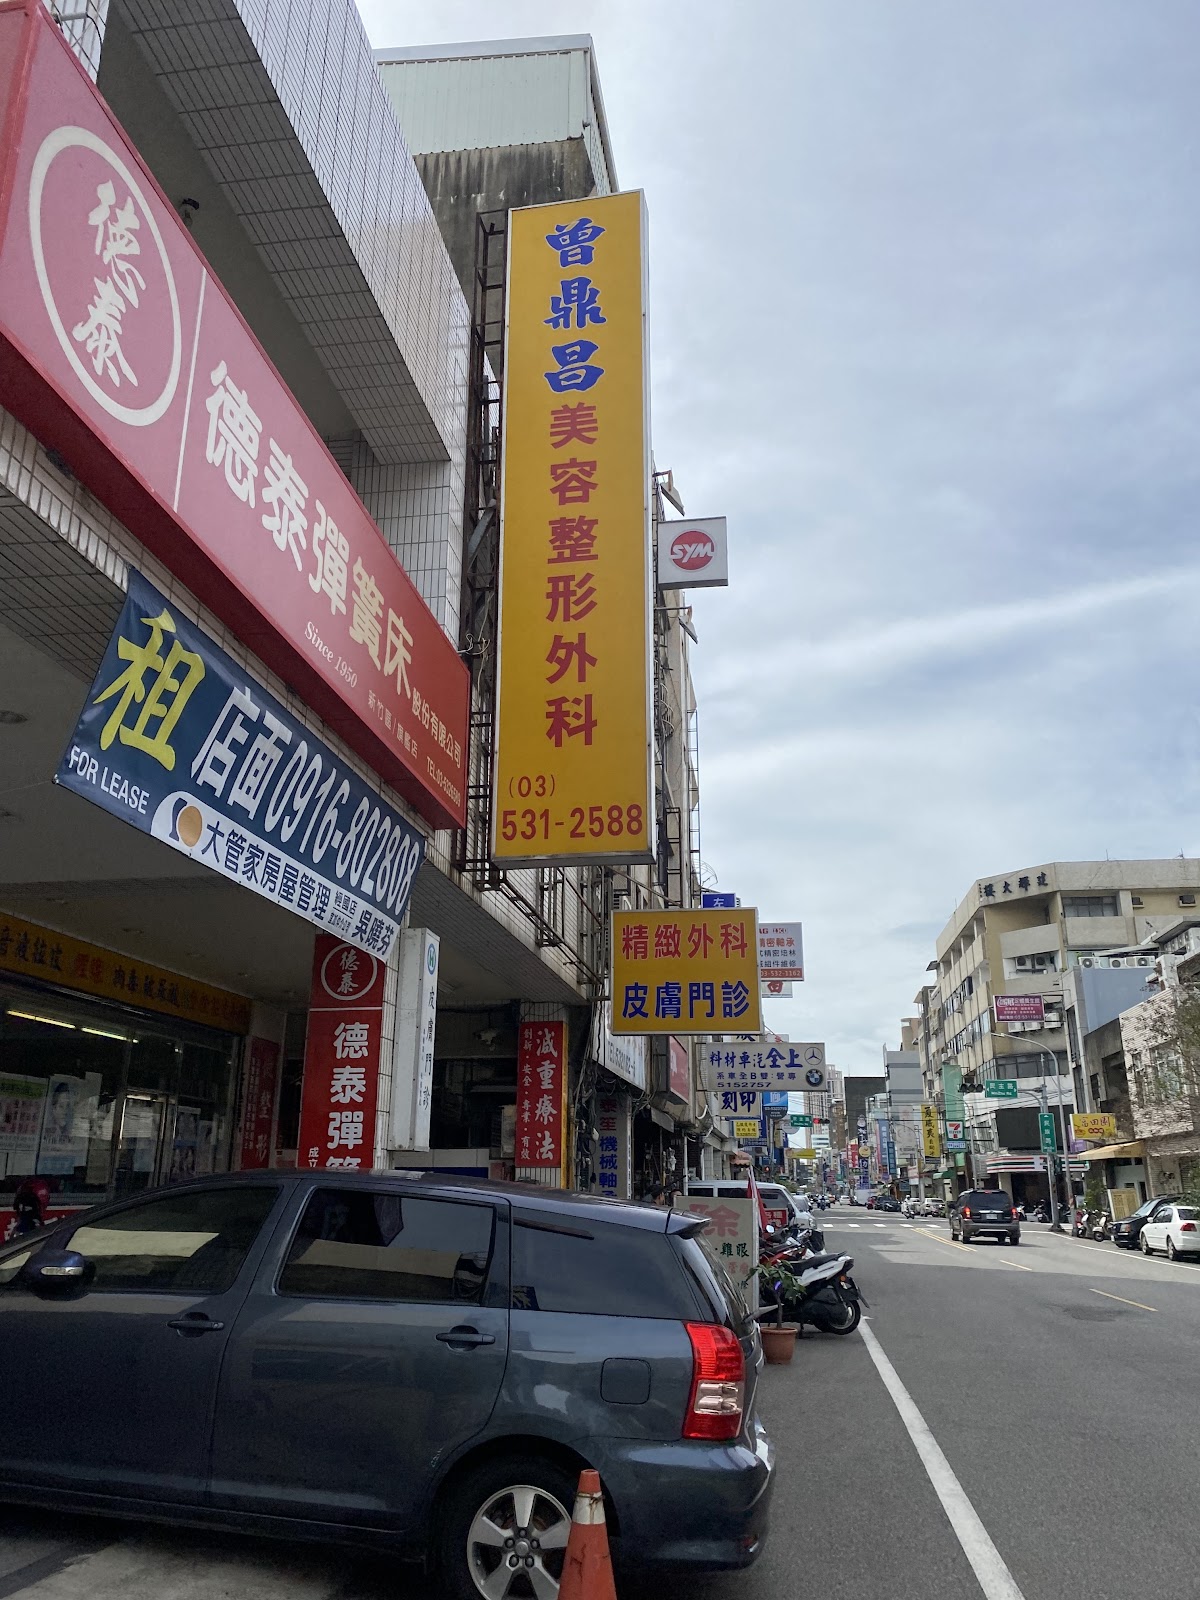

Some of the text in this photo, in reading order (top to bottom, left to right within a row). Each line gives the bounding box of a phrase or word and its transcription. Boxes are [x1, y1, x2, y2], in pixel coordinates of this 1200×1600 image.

[72, 181, 146, 387] 德泰
[543, 217, 607, 393] 曾鼎昌
[206, 361, 413, 701] 德泰彈簧床
[670, 541, 716, 563] SYM
[545, 402, 599, 748] 美容整形外科
[304, 620, 359, 689] Since 1950
[93, 608, 206, 771] 租
[412, 687, 461, 768] 股份有限公司
[68, 746, 150, 814] FOR LEASE
[190, 686, 421, 916] 店面 0916-802808
[509, 774, 556, 799] (03)
[502, 803, 643, 841] 531-2588
[201, 821, 332, 921] 大管家房屋管理
[351, 909, 394, 955] 吳曉芬
[622, 922, 749, 960] 精緻外科
[336, 949, 360, 994] 德泰
[622, 980, 750, 1019] 皮膚門診
[534, 1028, 558, 1160] 減重療法
[689, 1203, 741, 1237] 除
